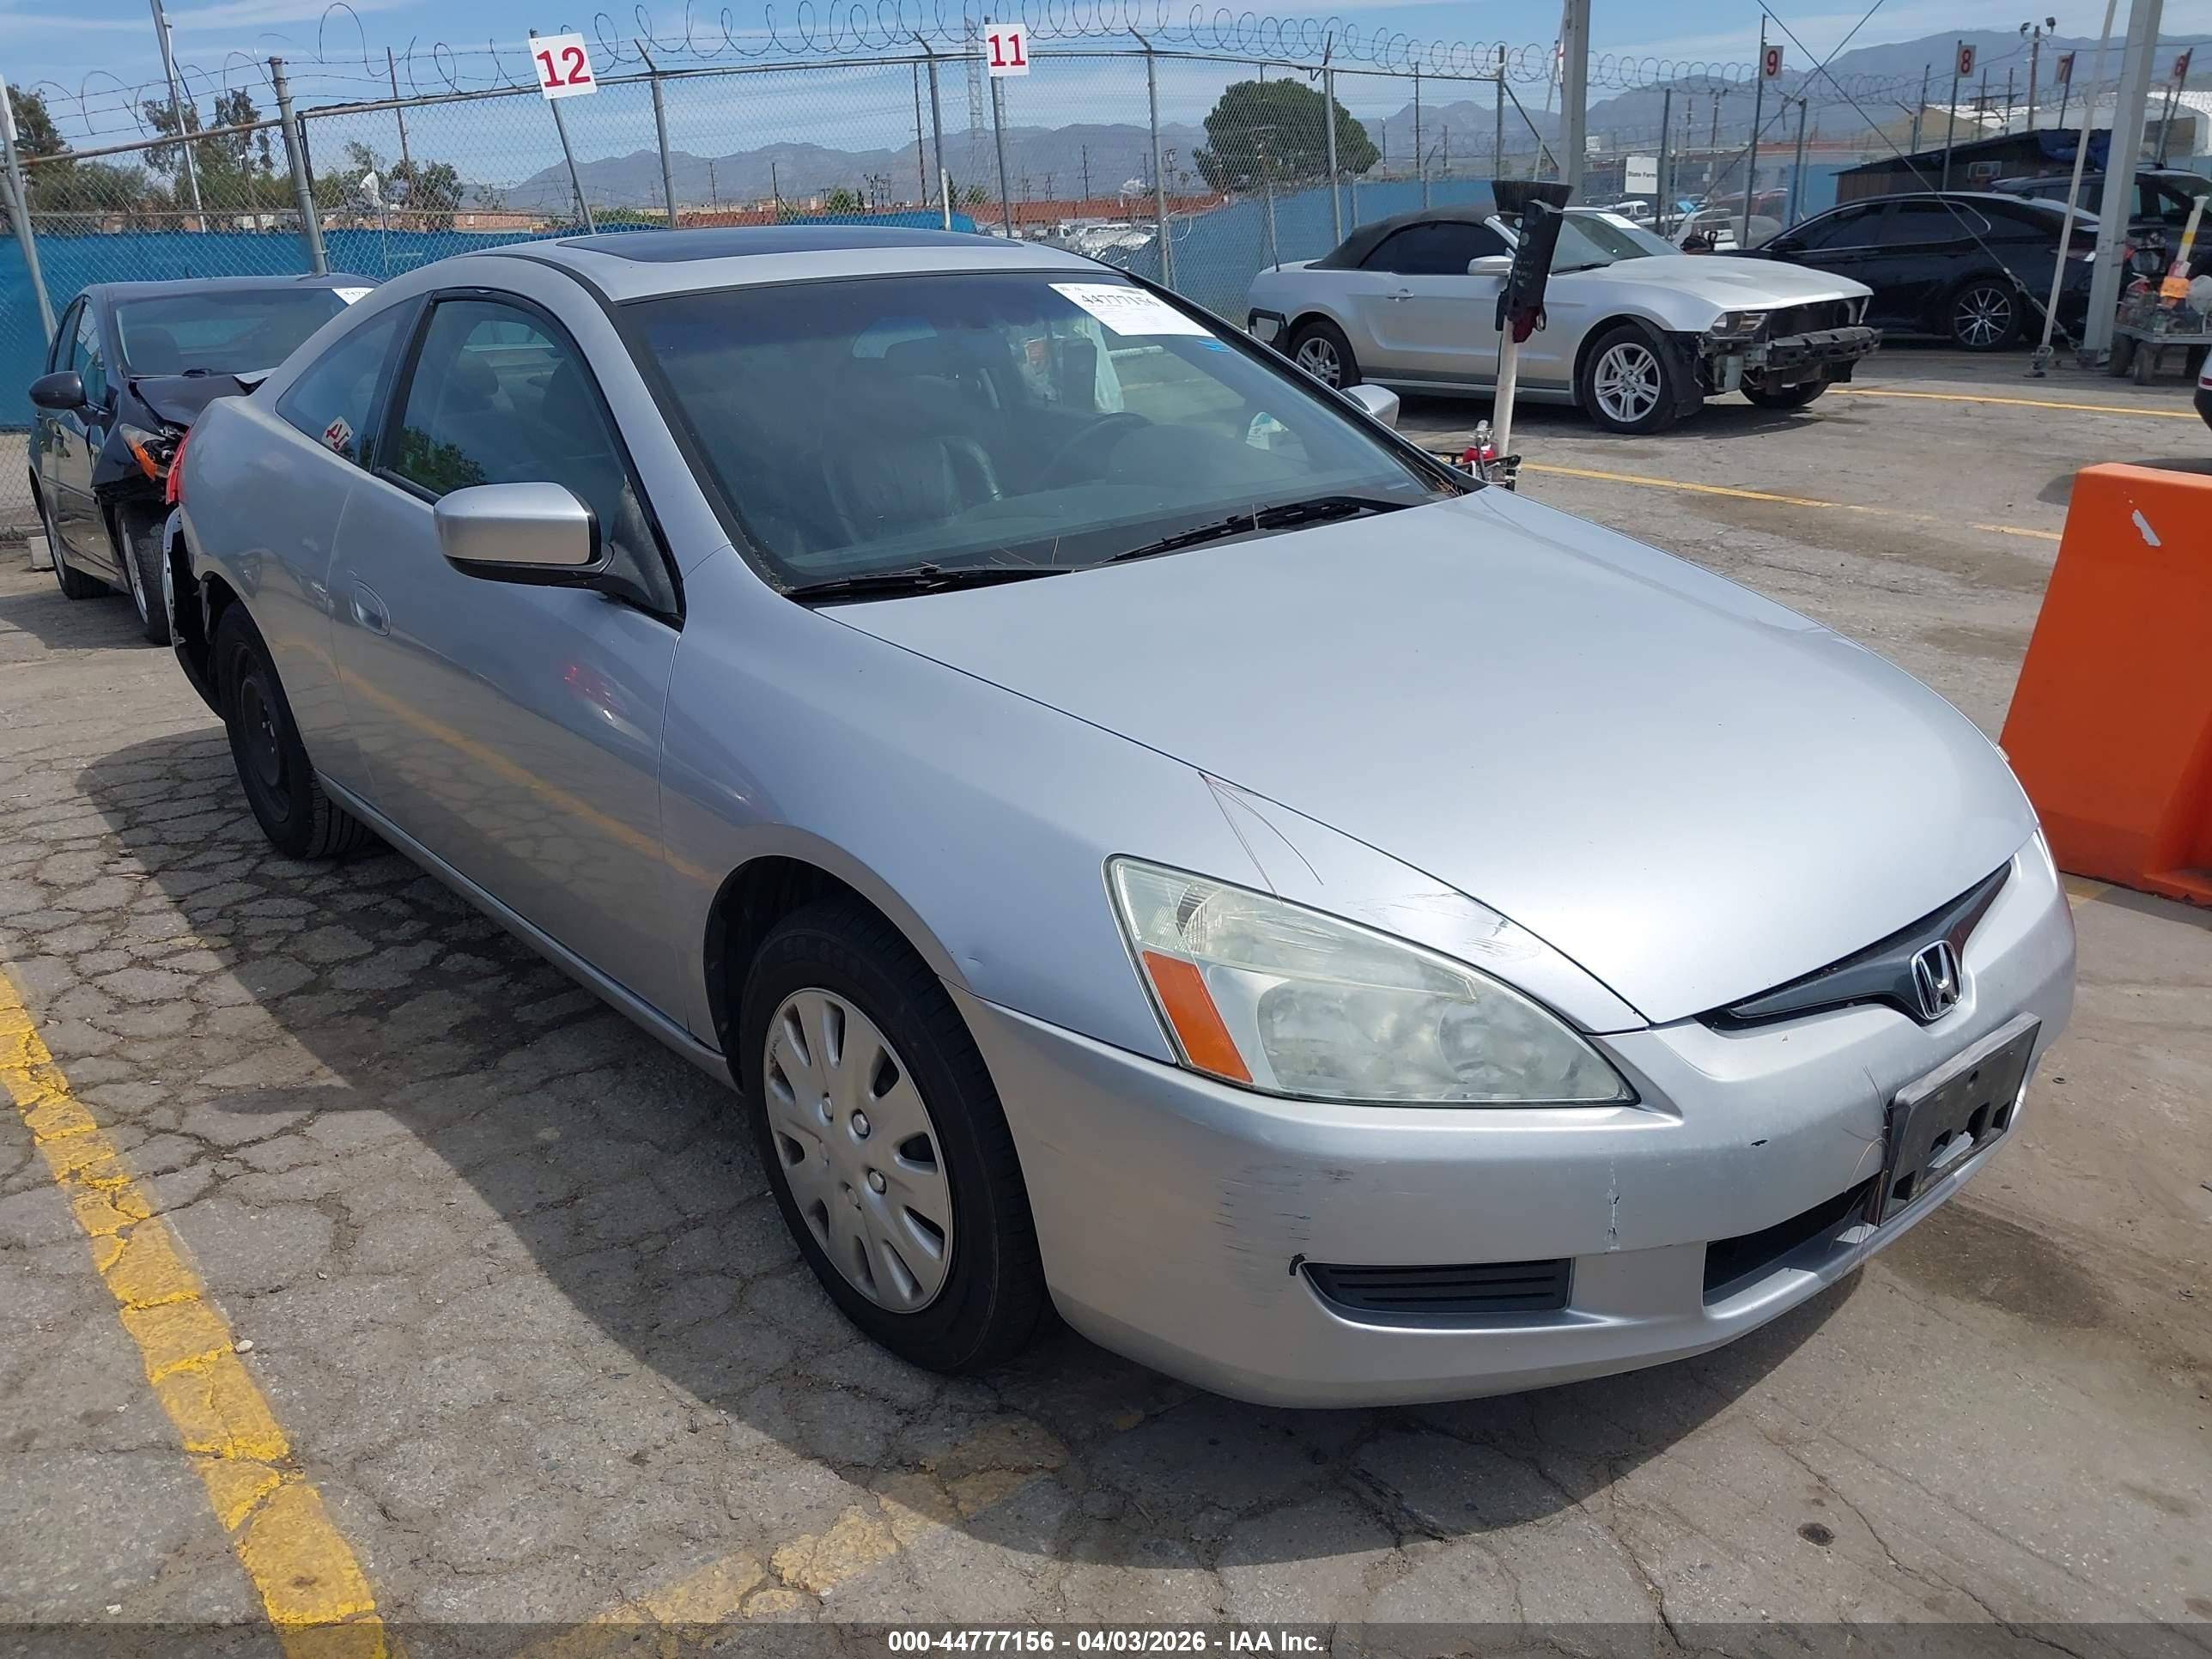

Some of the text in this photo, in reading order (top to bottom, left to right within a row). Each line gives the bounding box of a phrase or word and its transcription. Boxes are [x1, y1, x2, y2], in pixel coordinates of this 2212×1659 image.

[988, 34, 1025, 66] 11
[1961, 49, 1971, 74] 8
[537, 47, 591, 87] 12
[1766, 50, 1778, 76] 9
[2059, 58, 2069, 82] 7
[1081, 295, 1160, 307] 44777156
